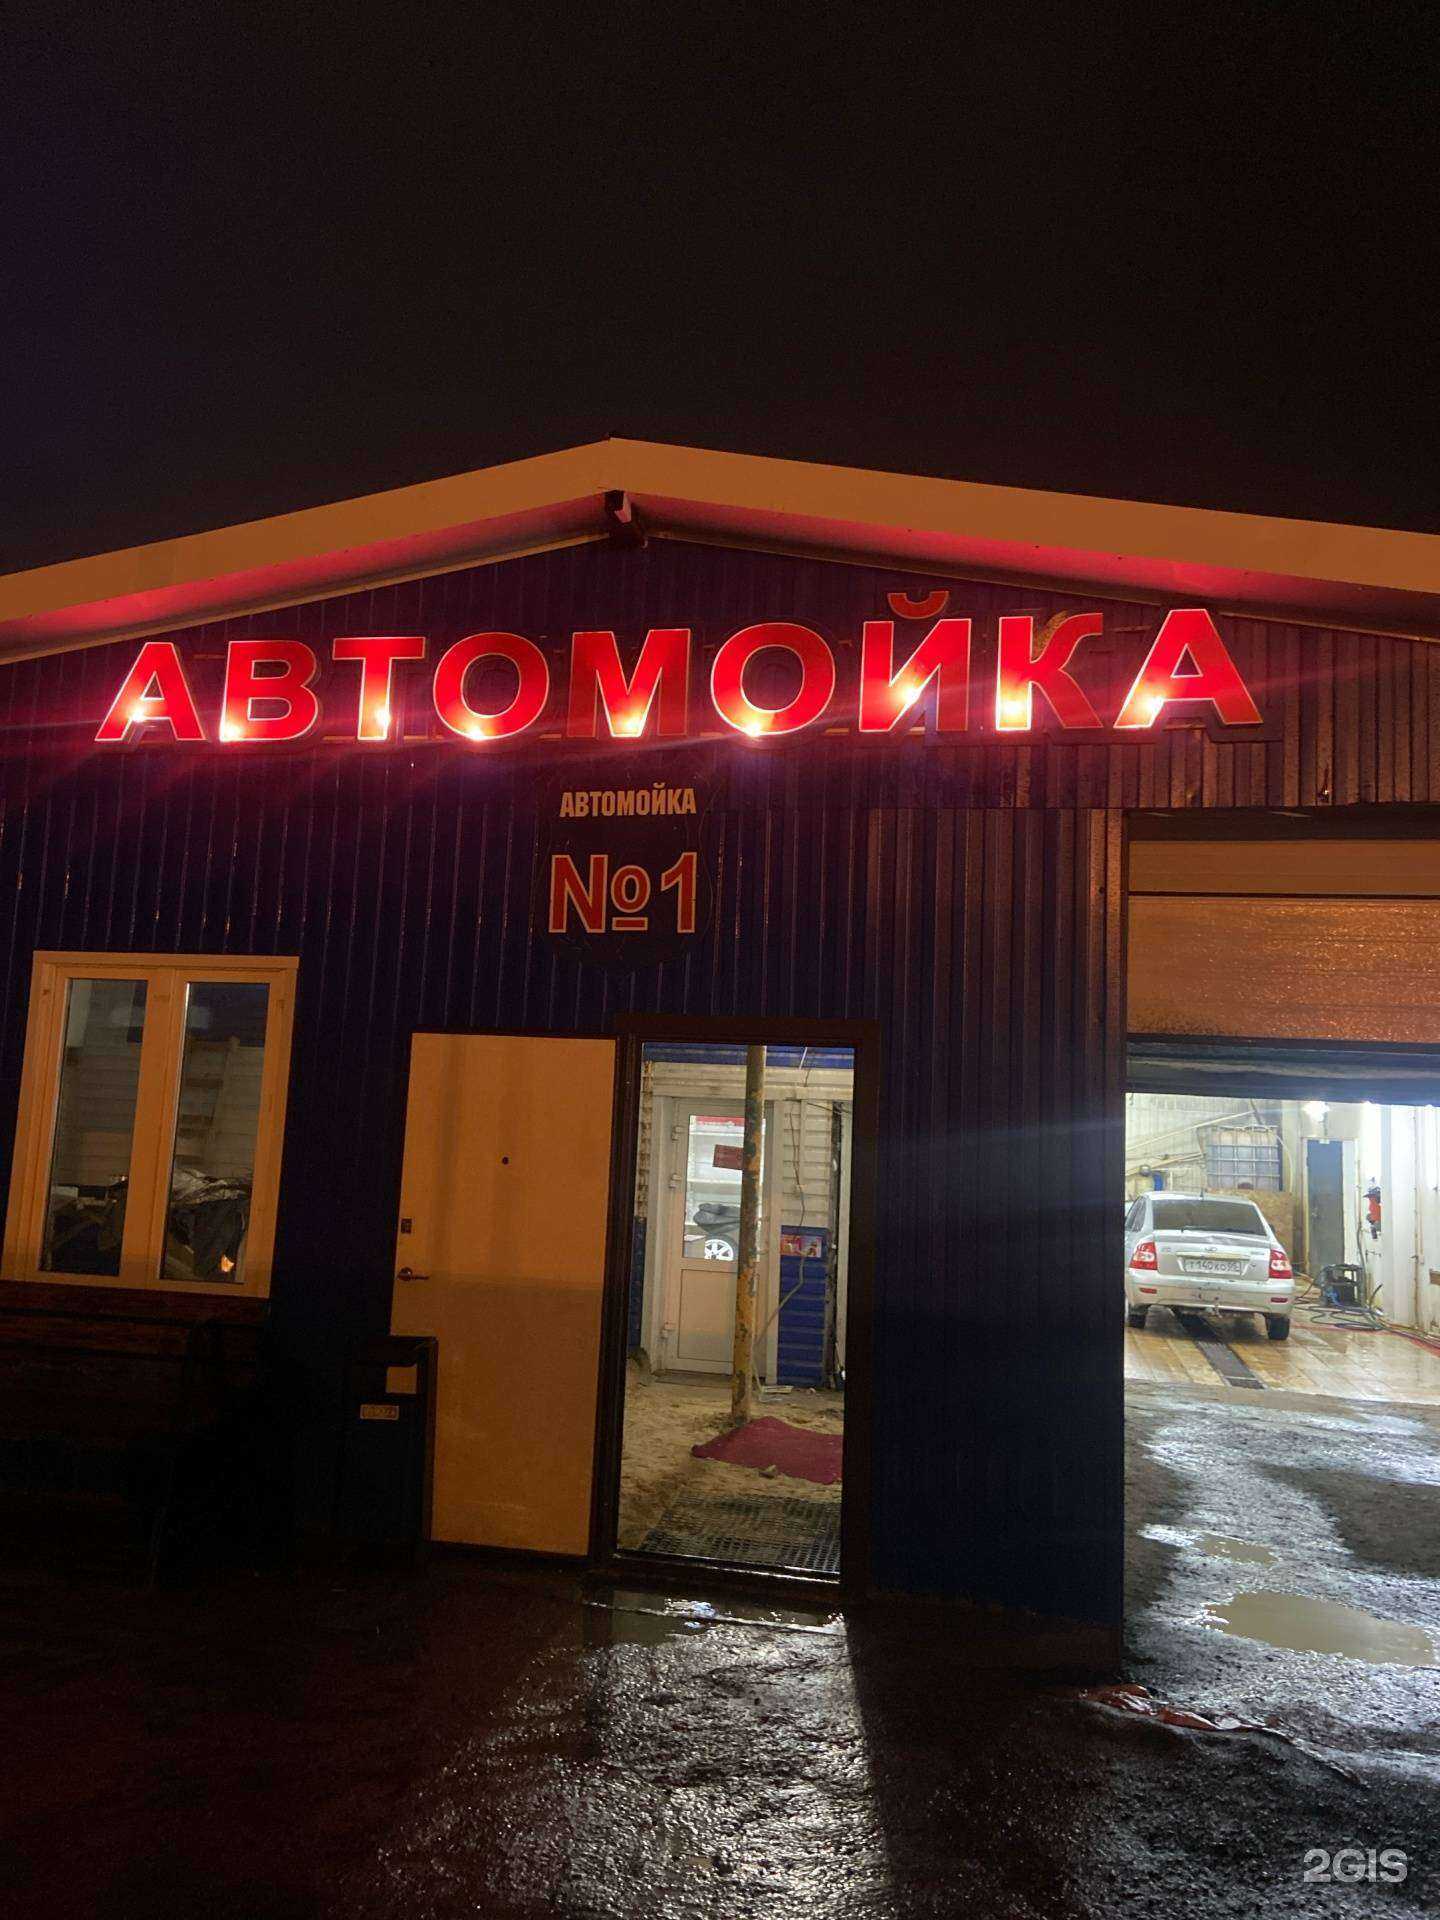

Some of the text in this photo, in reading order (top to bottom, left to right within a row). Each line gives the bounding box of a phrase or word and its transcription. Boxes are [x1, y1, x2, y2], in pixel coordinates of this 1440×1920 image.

[95, 590, 1263, 742] АВТОМОЙКА
[559, 782, 697, 817] АВТОМОЙКА
[548, 852, 698, 933] №1
